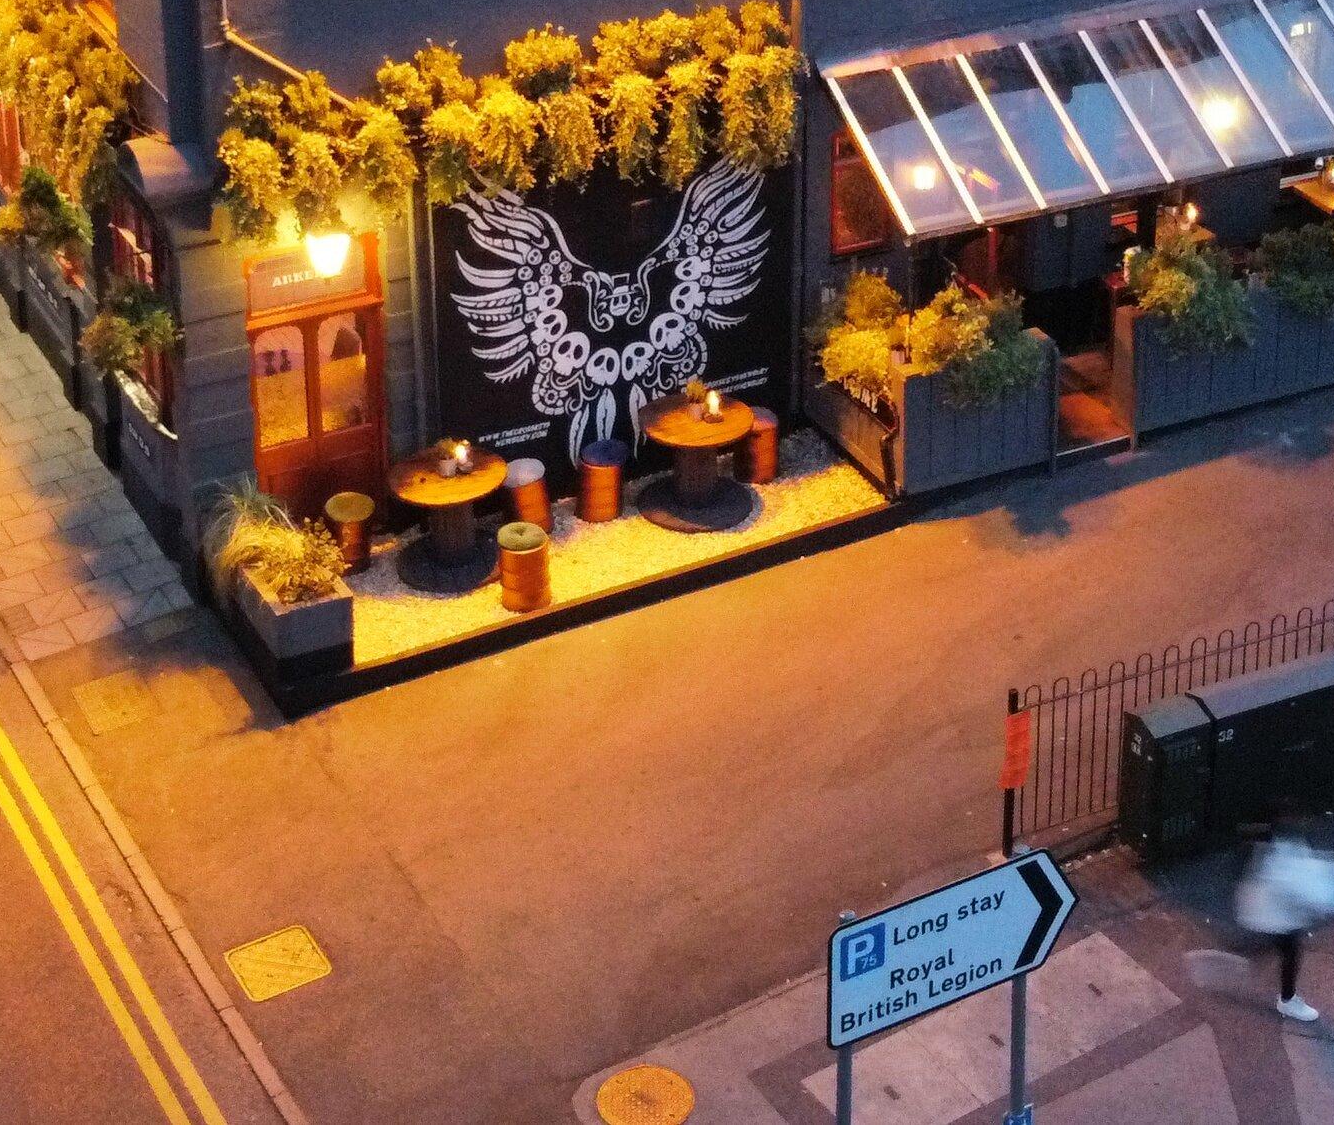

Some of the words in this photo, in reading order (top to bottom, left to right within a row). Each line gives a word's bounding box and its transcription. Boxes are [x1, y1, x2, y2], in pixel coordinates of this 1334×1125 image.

[893, 912, 948, 945] Long
[957, 890, 1005, 921] stay
[841, 990, 918, 1033] British
[929, 958, 1002, 998] Legion
[890, 949, 954, 989] Royal
